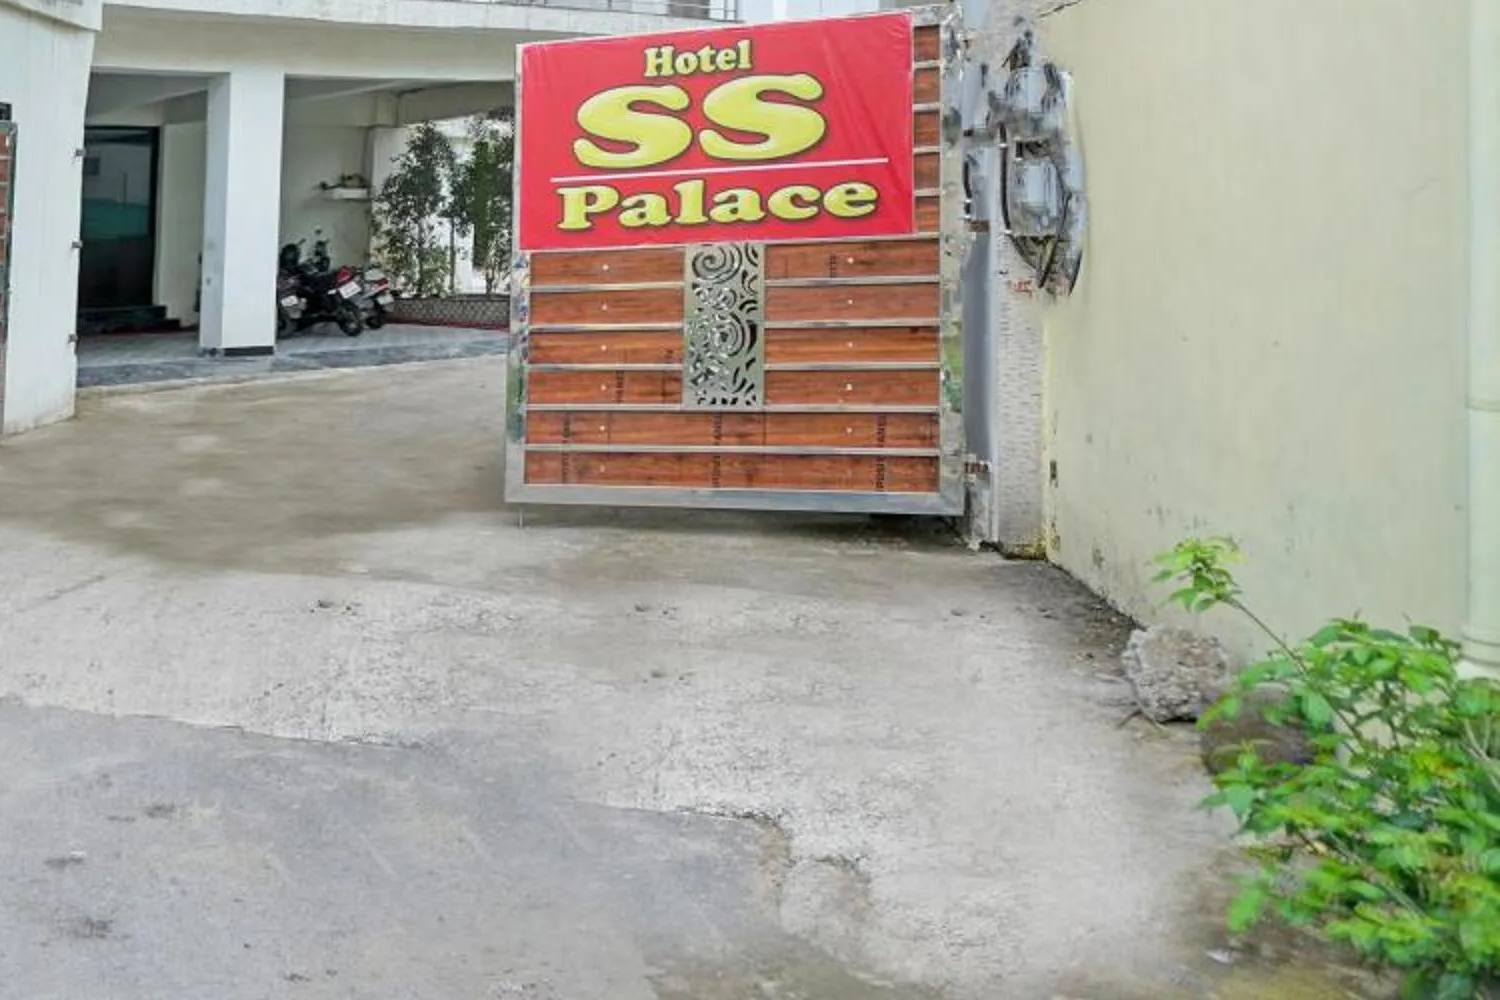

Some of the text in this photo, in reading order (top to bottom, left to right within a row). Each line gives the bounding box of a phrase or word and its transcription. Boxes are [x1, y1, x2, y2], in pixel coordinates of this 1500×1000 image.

[644, 39, 752, 77] Hotel
[573, 73, 827, 169] SS
[556, 179, 879, 231] Palace
